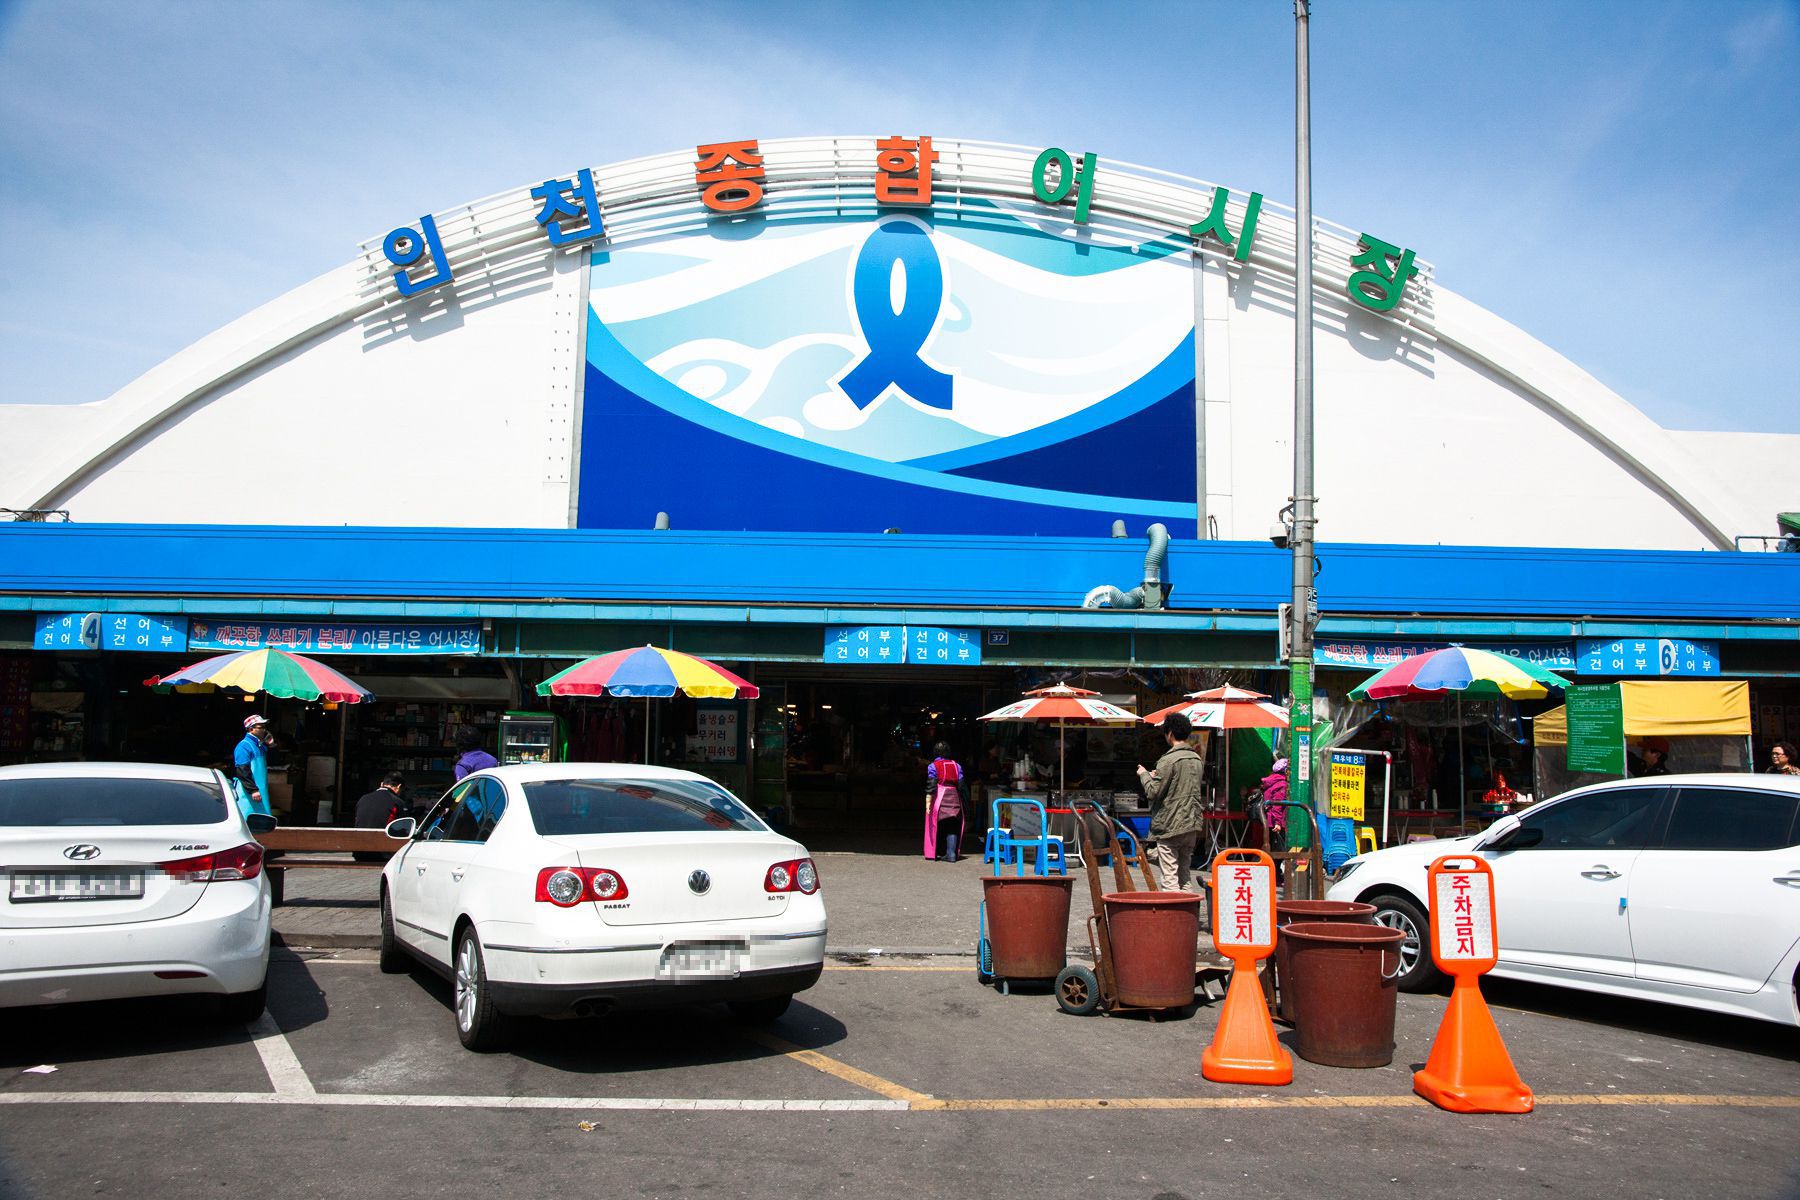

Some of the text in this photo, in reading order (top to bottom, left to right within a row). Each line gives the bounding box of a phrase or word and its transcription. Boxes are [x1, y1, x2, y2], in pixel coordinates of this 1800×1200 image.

[114, 617, 173, 631] 선어부
[85, 619, 98, 644] 4
[215, 626, 261, 646] 깨끗한
[265, 628, 313, 648] 쓰레기
[317, 629, 357, 649] 분리!
[362, 630, 421, 649] 아름다운
[837, 630, 891, 643] 선어부
[916, 631, 969, 644] 선어부
[113, 634, 173, 647] 건어부
[837, 647, 891, 660] 건어부
[916, 648, 969, 661] 건어부
[1591, 642, 1647, 655] 선어부
[1661, 644, 1672, 669] 6
[1590, 658, 1647, 671] 건어부
[1233, 867, 1253, 943] 주차금지
[1452, 875, 1475, 957] 주차금지
